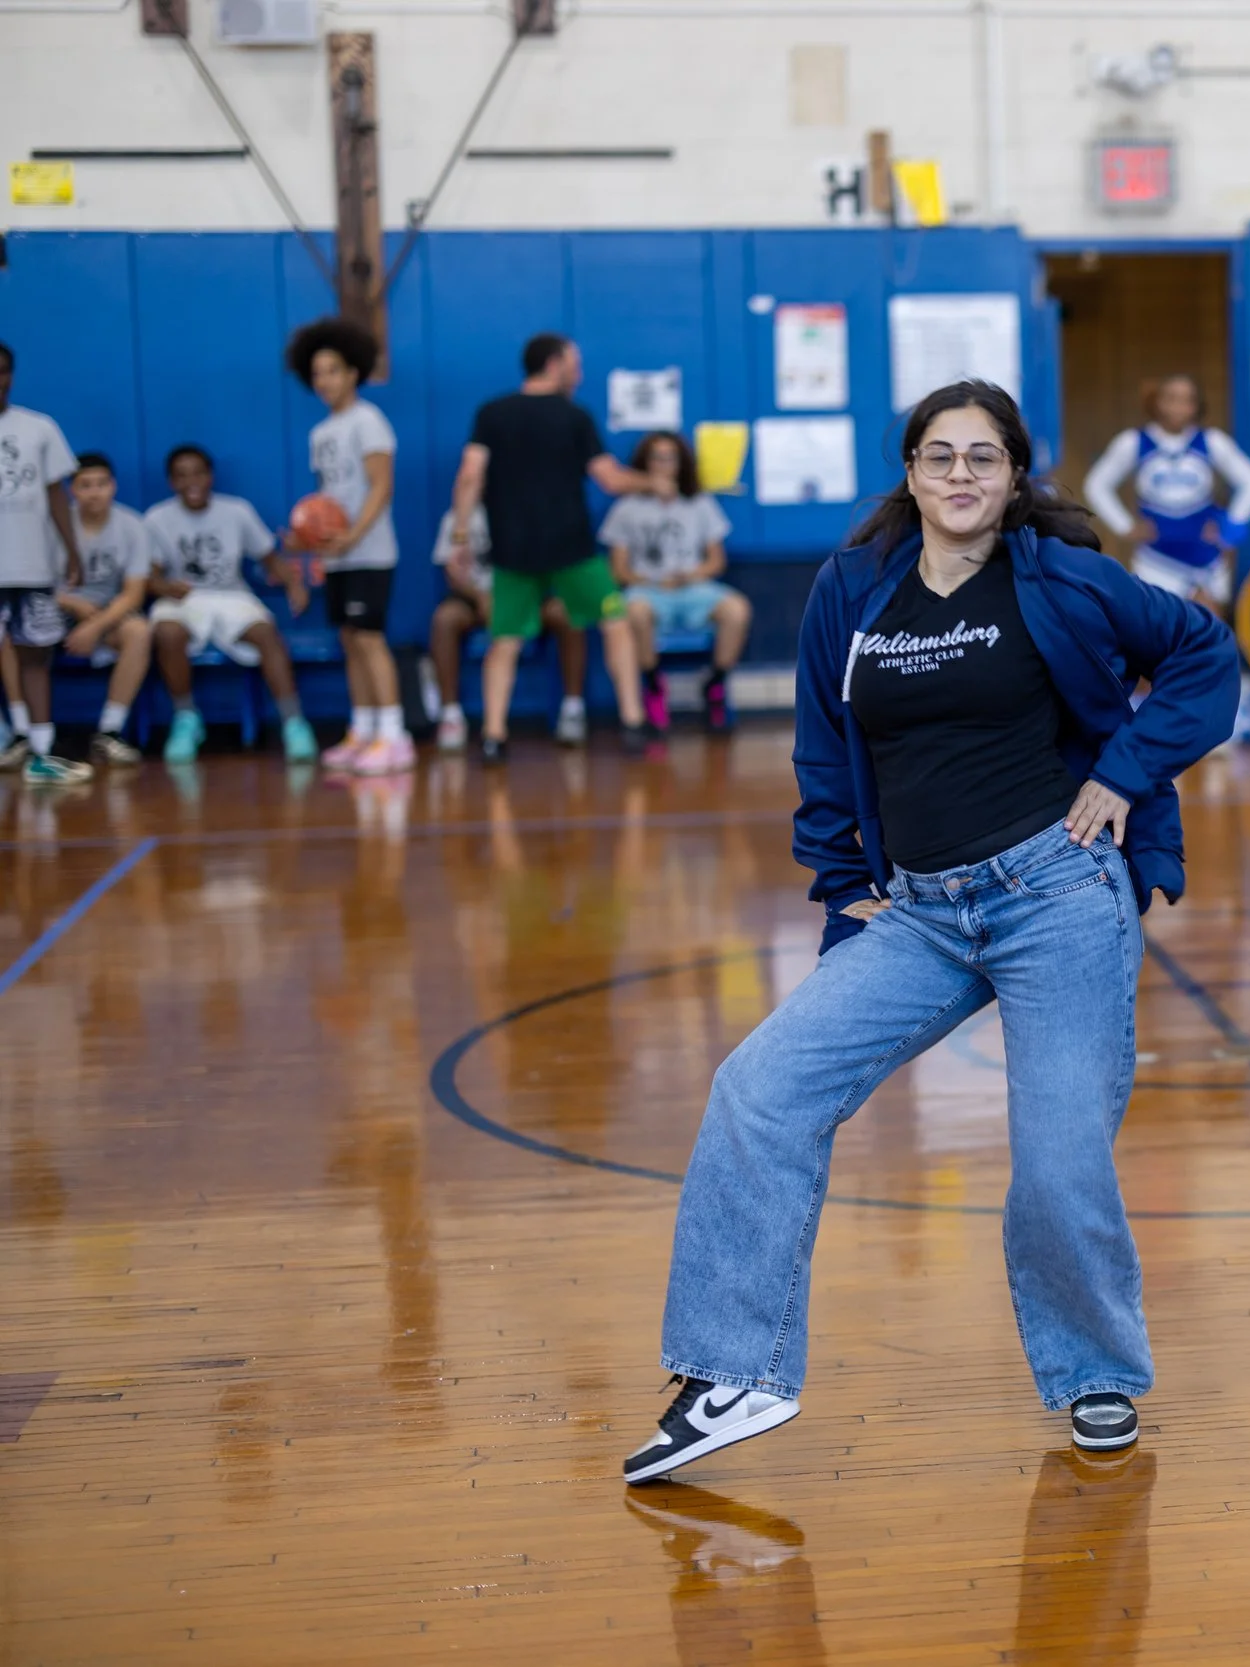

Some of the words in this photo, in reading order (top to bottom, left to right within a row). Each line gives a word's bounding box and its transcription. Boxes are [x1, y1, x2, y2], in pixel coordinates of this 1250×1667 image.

[877, 653, 934, 669] ATHLETIC
[935, 647, 965, 662] CLUB
[901, 662, 940, 675] EST.1991
